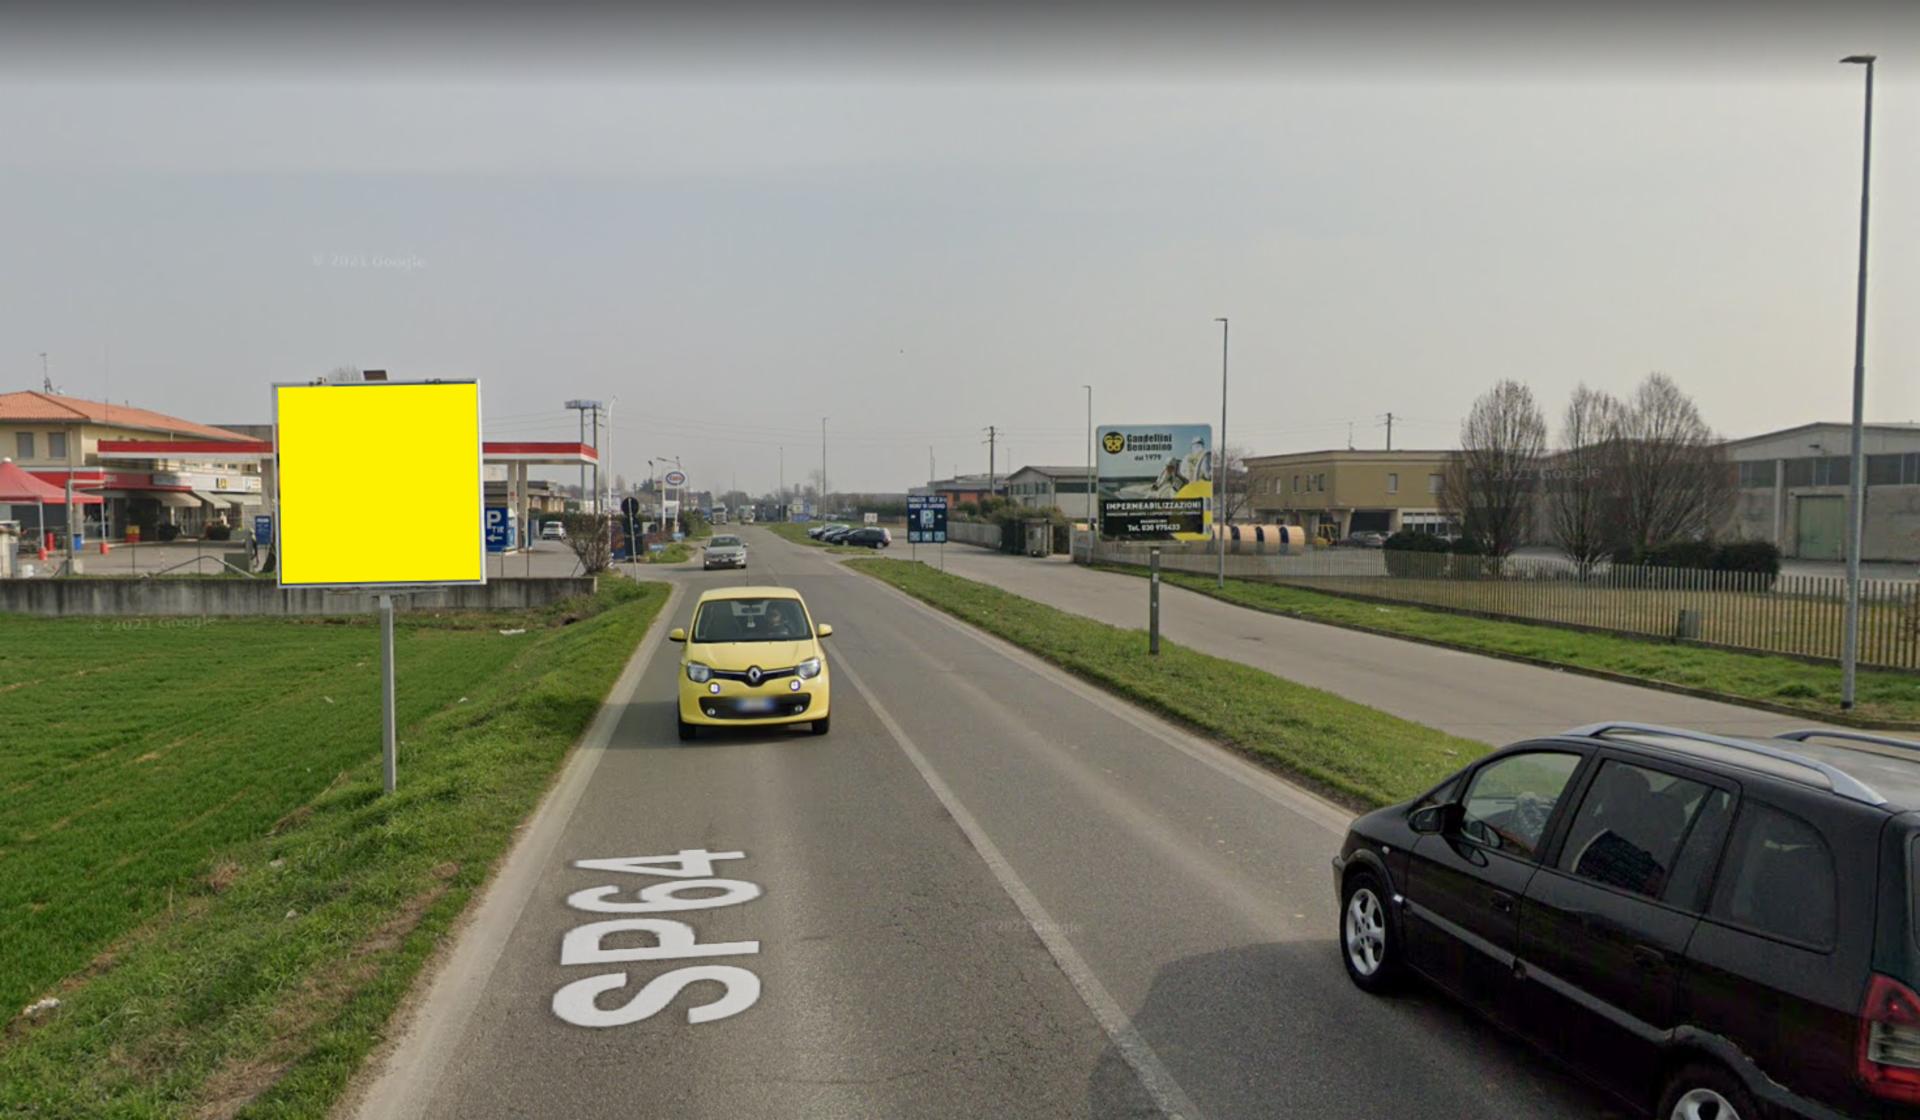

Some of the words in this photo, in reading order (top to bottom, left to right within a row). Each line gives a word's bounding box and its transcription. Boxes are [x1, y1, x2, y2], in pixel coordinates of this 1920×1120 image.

[1106, 502, 1200, 510] IMPERMEABILIZZAZIONI
[487, 510, 501, 528] P
[552, 849, 762, 1028] SP64
